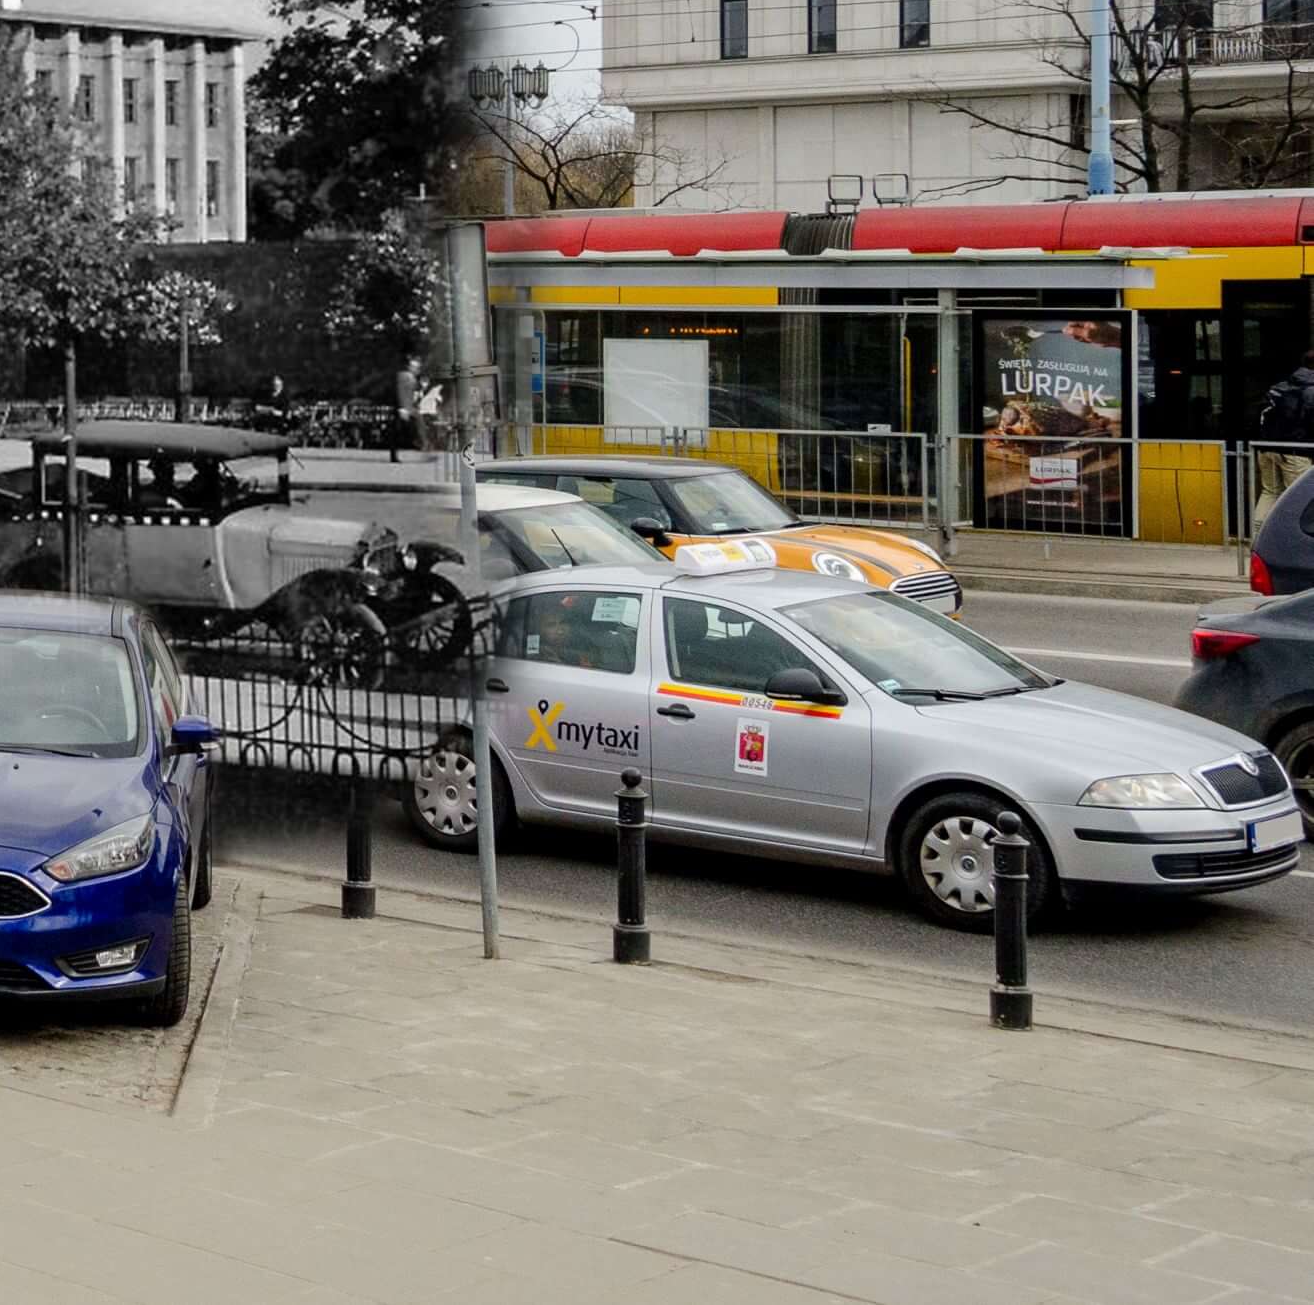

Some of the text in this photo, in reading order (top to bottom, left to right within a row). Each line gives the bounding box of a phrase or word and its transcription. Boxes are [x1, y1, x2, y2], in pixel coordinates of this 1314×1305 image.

[1092, 367, 1109, 377] NA
[1001, 370, 1108, 407] LURPAK
[557, 720, 640, 751] mytaxi
